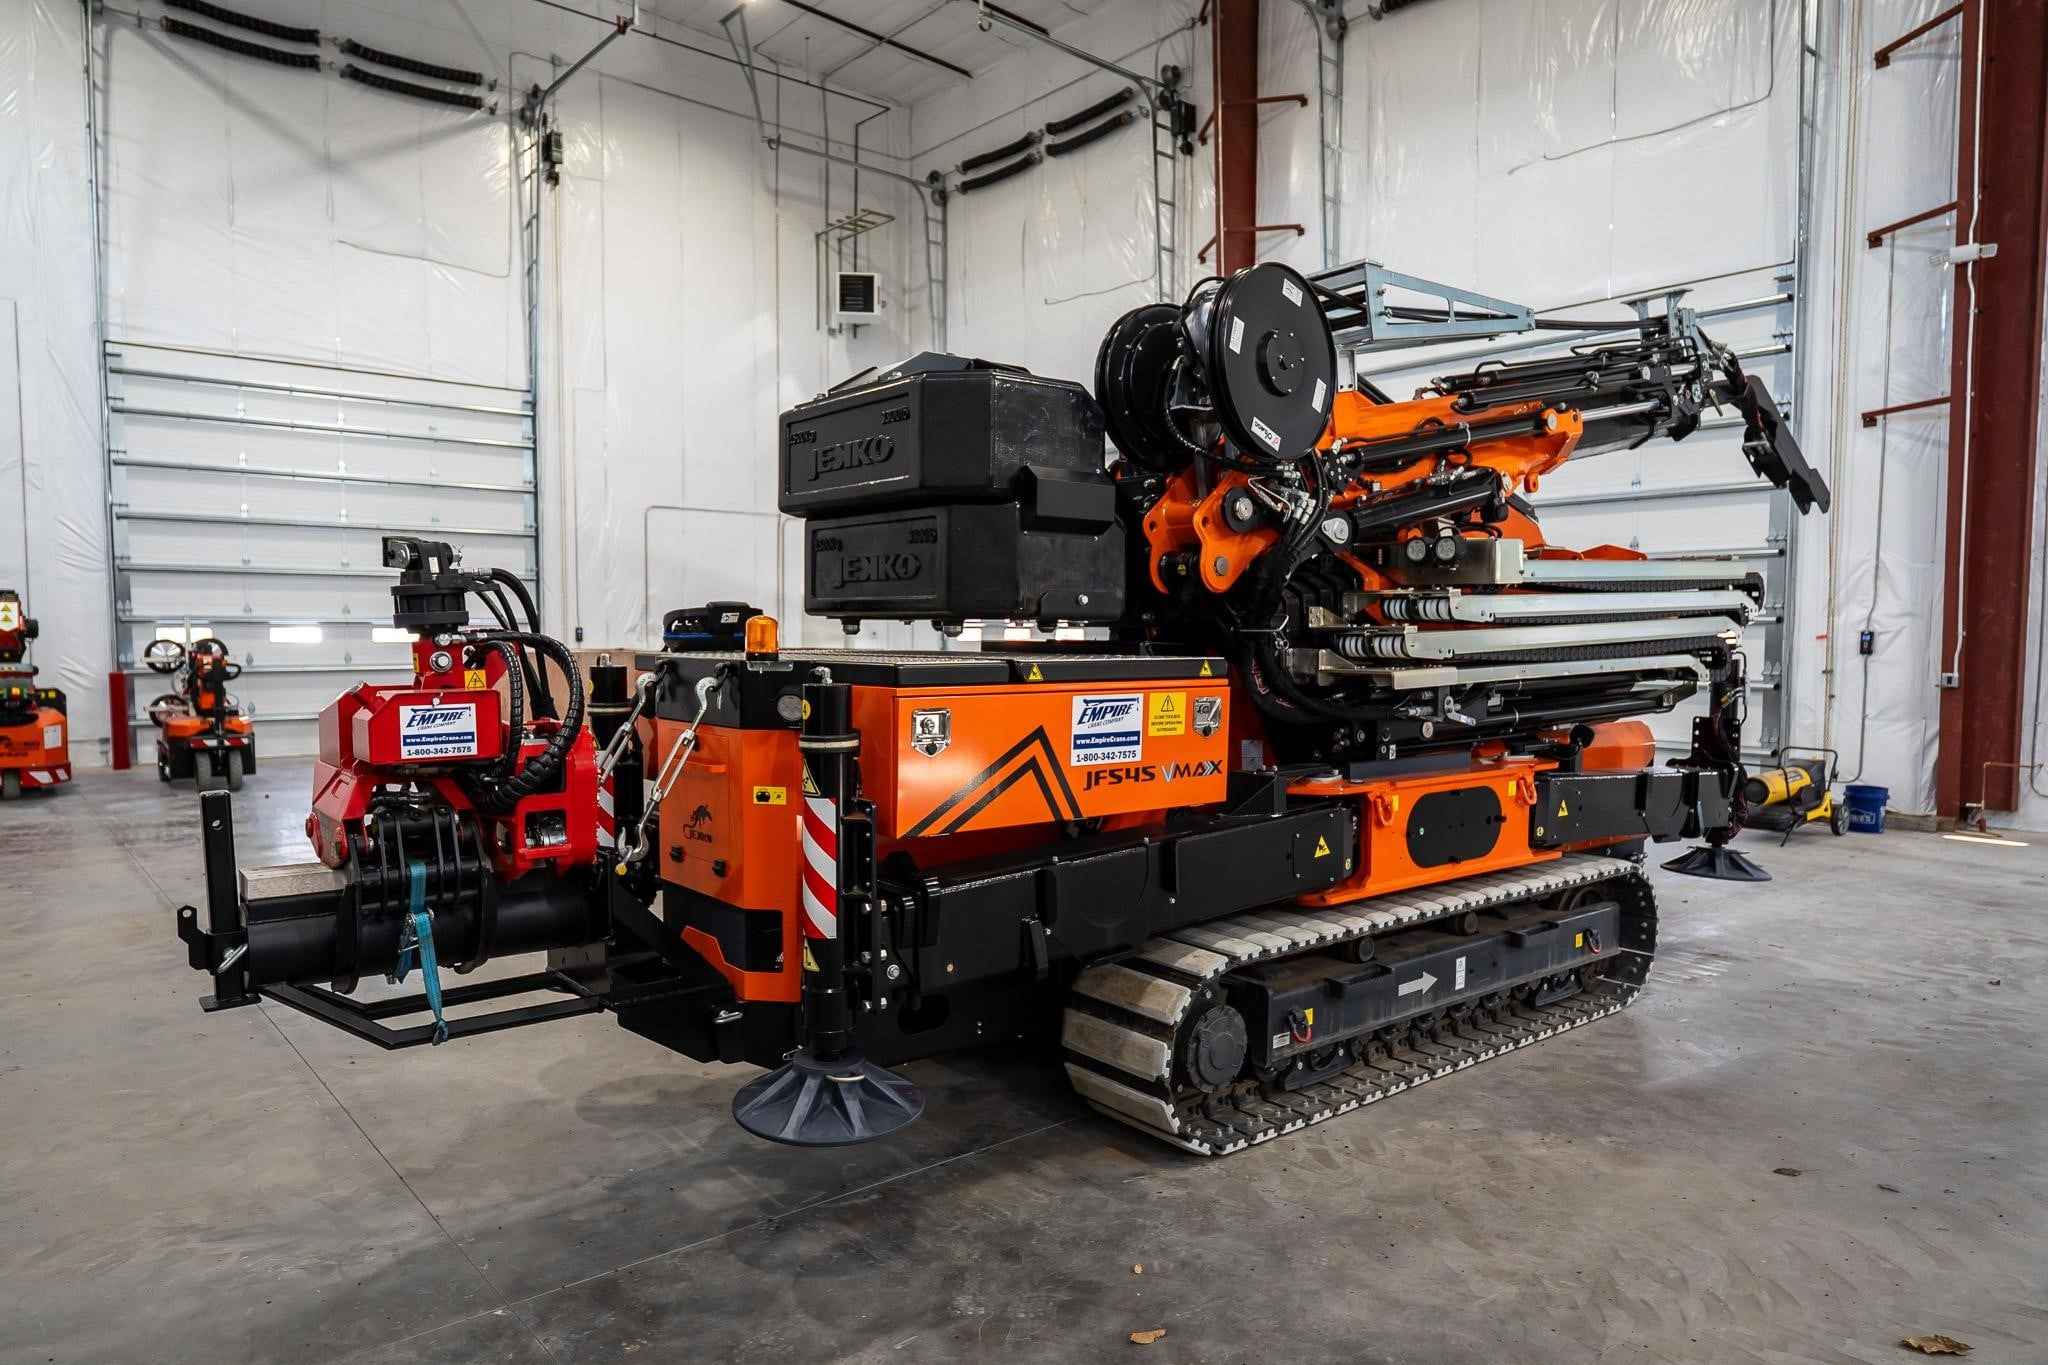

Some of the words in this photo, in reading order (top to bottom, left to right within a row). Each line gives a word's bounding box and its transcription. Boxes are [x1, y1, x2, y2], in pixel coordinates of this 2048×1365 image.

[808, 434, 895, 481] JEKKO
[833, 553, 922, 590] JEKKO
[406, 711, 466, 728] EMPIRE
[1077, 703, 1134, 725] EMPIRE
[406, 746, 472, 756] 1-800-342-7575
[1076, 750, 1137, 763] 1-800-342-7575
